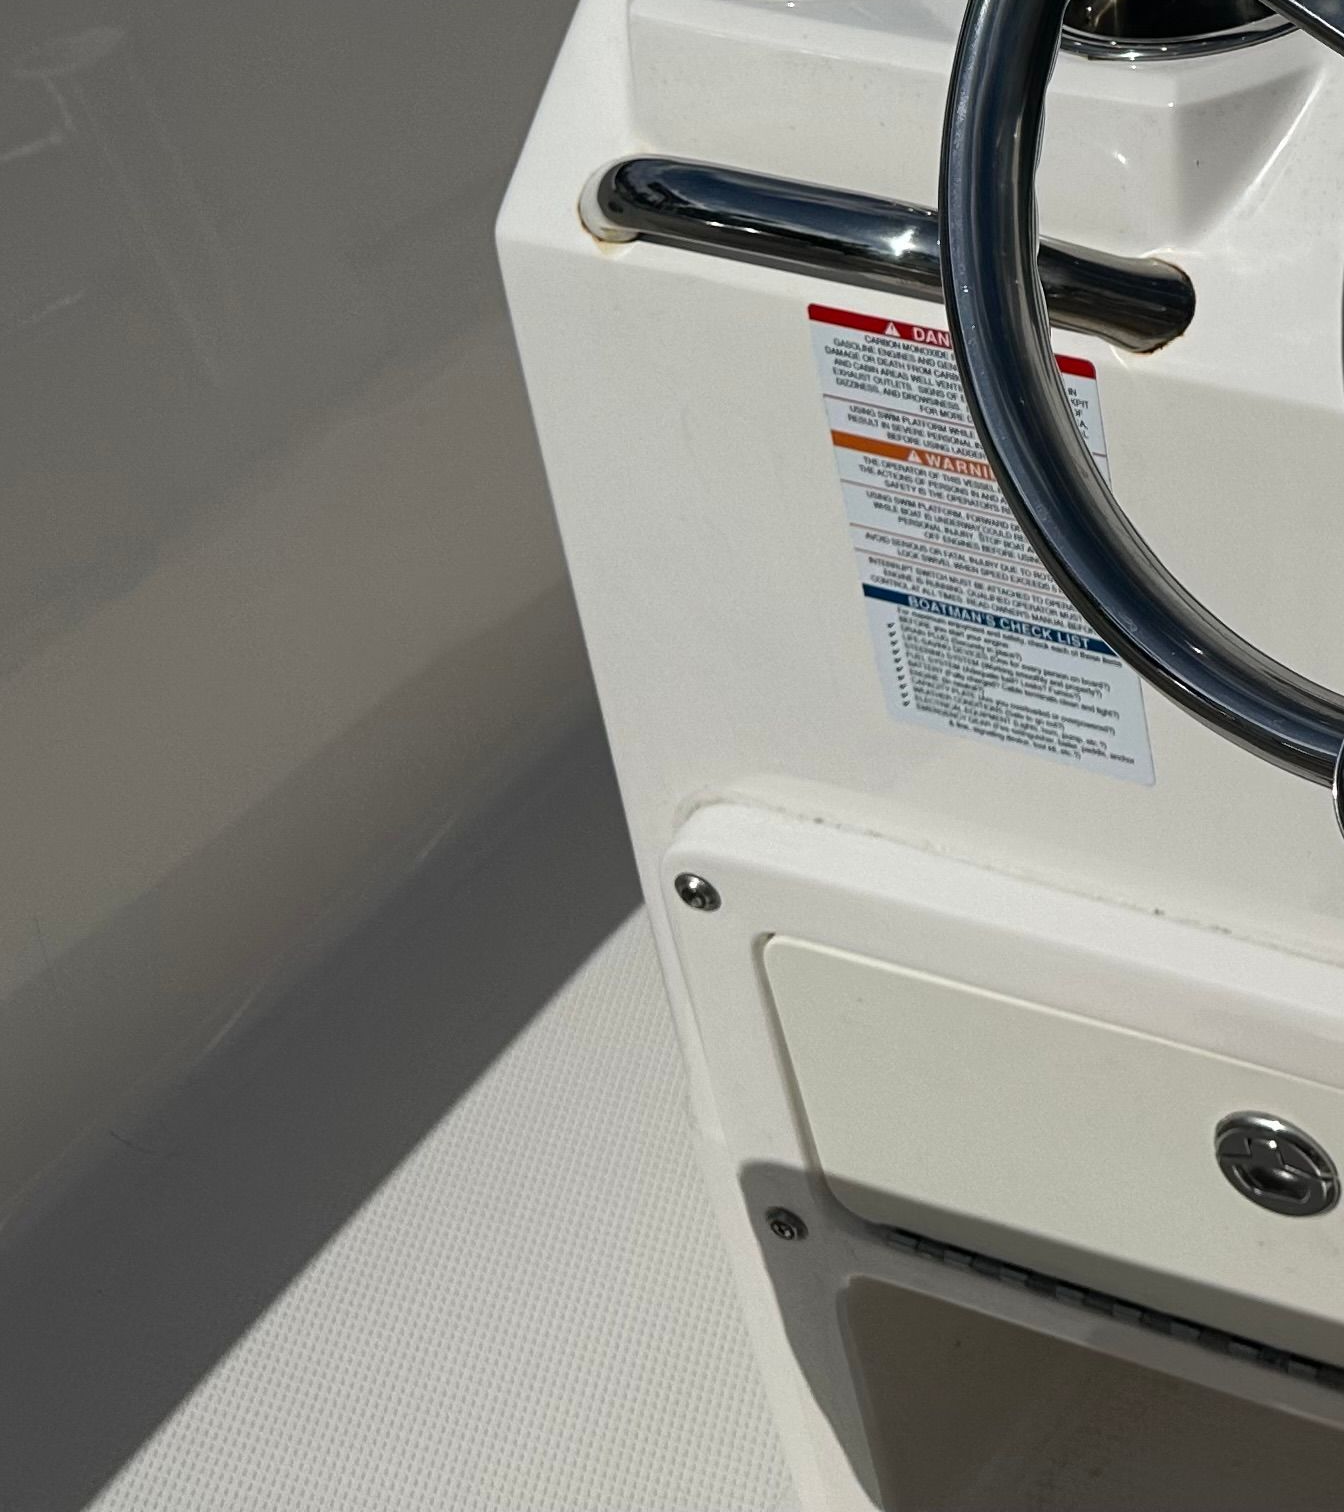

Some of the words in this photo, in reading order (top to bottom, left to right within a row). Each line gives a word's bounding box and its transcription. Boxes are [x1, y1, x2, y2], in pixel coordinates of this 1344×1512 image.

[907, 594, 996, 628] BOATMAN'S
[998, 616, 1053, 641] CHECK
[1056, 630, 1091, 650] LIST
